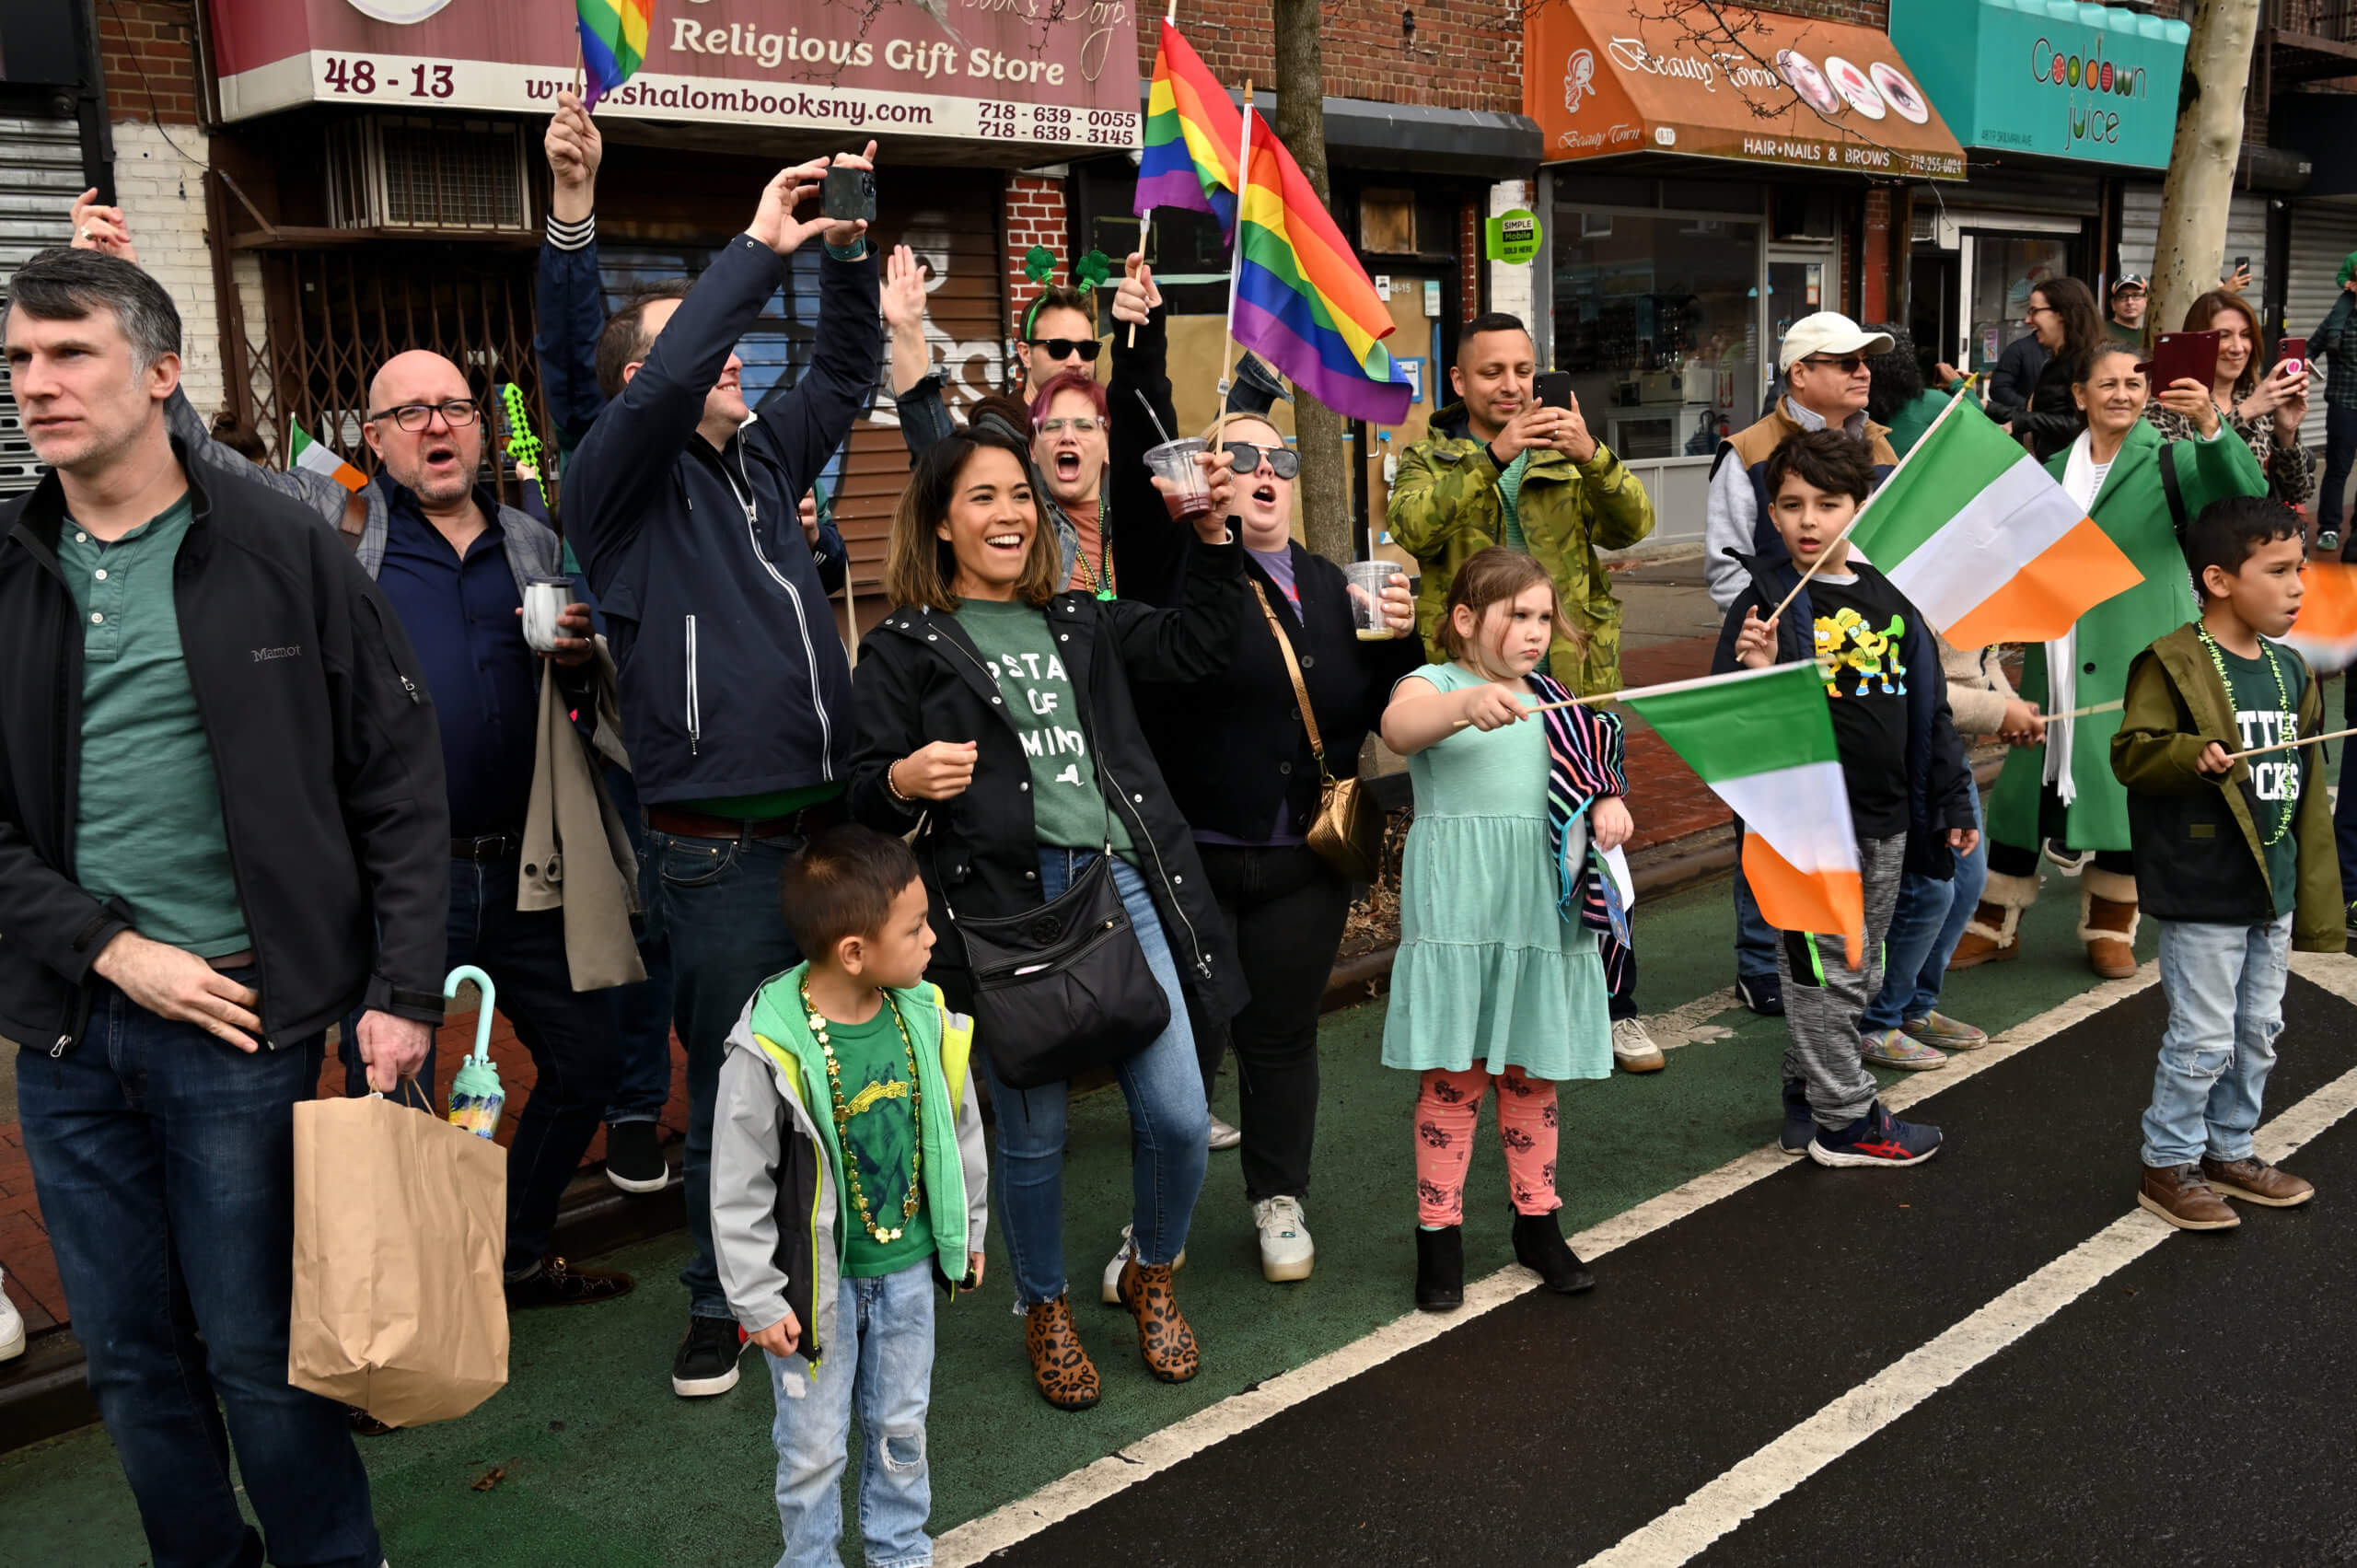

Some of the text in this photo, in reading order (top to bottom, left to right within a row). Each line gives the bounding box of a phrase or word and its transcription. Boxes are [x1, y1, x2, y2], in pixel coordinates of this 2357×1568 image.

[670, 17, 1064, 86] Religious Gift Store
[1608, 37, 1781, 92] Beauty Town
[2032, 33, 2146, 99] Cooldown
[324, 57, 376, 94] 48
[410, 64, 454, 99] 13
[526, 79, 933, 126] ww.shalombooksny.com
[978, 102, 1016, 120] 718
[1033, 106, 1072, 123] 639
[1087, 110, 1136, 128] 0055
[978, 121, 1016, 138] 718
[1032, 124, 1072, 141] 639
[1086, 128, 1133, 145] 3145
[1558, 123, 1640, 150] Beauty Town
[2064, 93, 2119, 151] juice
[1744, 138, 1890, 167] HAIR NAILS & BROWS
[1504, 220, 1532, 230] SIMPLE
[1505, 230, 1531, 240] Mobile
[250, 645, 302, 662] Marmot
[1018, 726, 1085, 758] MIND
[2247, 762, 2300, 800] CKS
